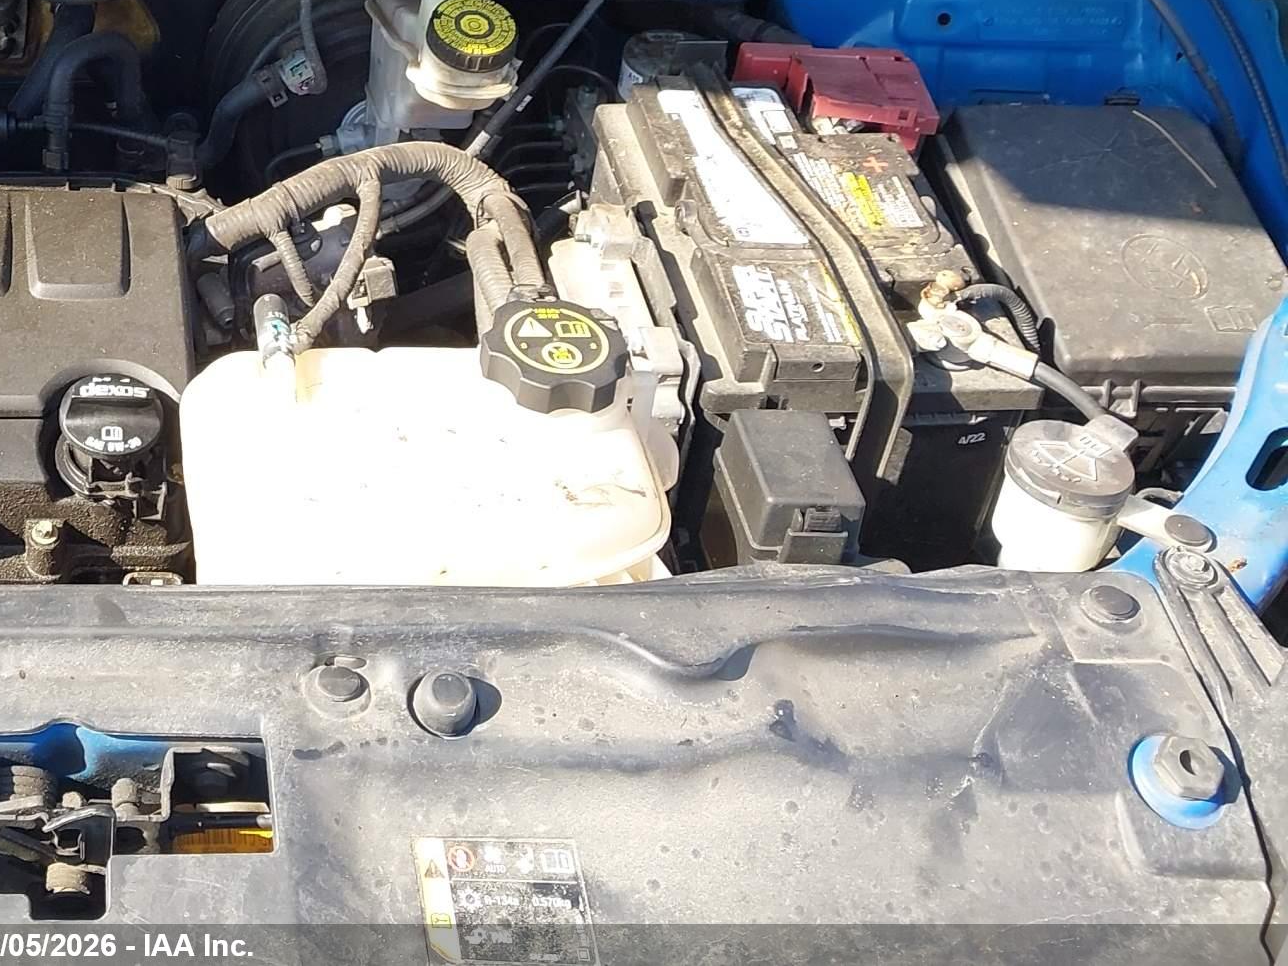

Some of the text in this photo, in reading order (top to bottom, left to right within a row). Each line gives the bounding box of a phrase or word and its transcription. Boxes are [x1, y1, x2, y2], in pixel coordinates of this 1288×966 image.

[757, 266, 794, 343] START
[776, 279, 820, 341] PLATINUM
[80, 383, 148, 397] dexos
[957, 432, 986, 445] 4/22
[485, 864, 506, 873] AUTO
